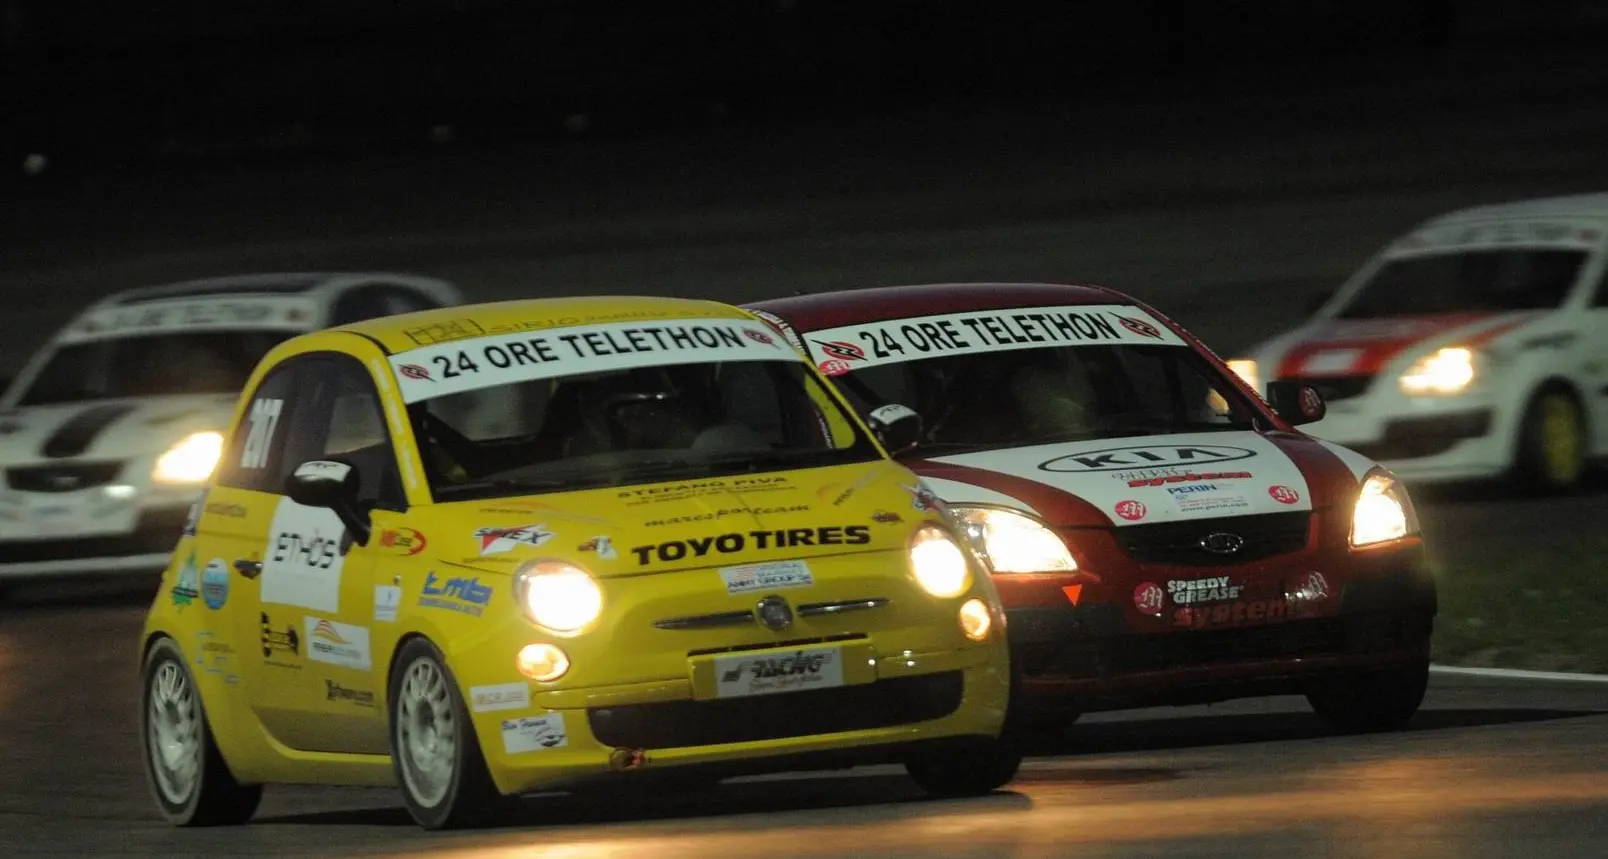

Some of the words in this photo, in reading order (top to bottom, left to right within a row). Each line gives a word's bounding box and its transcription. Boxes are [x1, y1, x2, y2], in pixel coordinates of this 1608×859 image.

[859, 330, 904, 358] 24
[901, 319, 970, 355] ORE
[960, 312, 1121, 345] TELETHON
[431, 354, 480, 380] 24
[483, 337, 561, 370] ORE
[556, 325, 747, 360] TELETHON
[1071, 447, 1226, 469] KIA
[617, 480, 725, 498] STEFANO
[1167, 483, 1217, 494] PERIN
[274, 531, 336, 569] ETHOS
[631, 532, 746, 566] TOYO
[748, 525, 872, 550] TIRES
[1167, 575, 1230, 593] SPEEDY
[1173, 586, 1240, 603] GREASE
